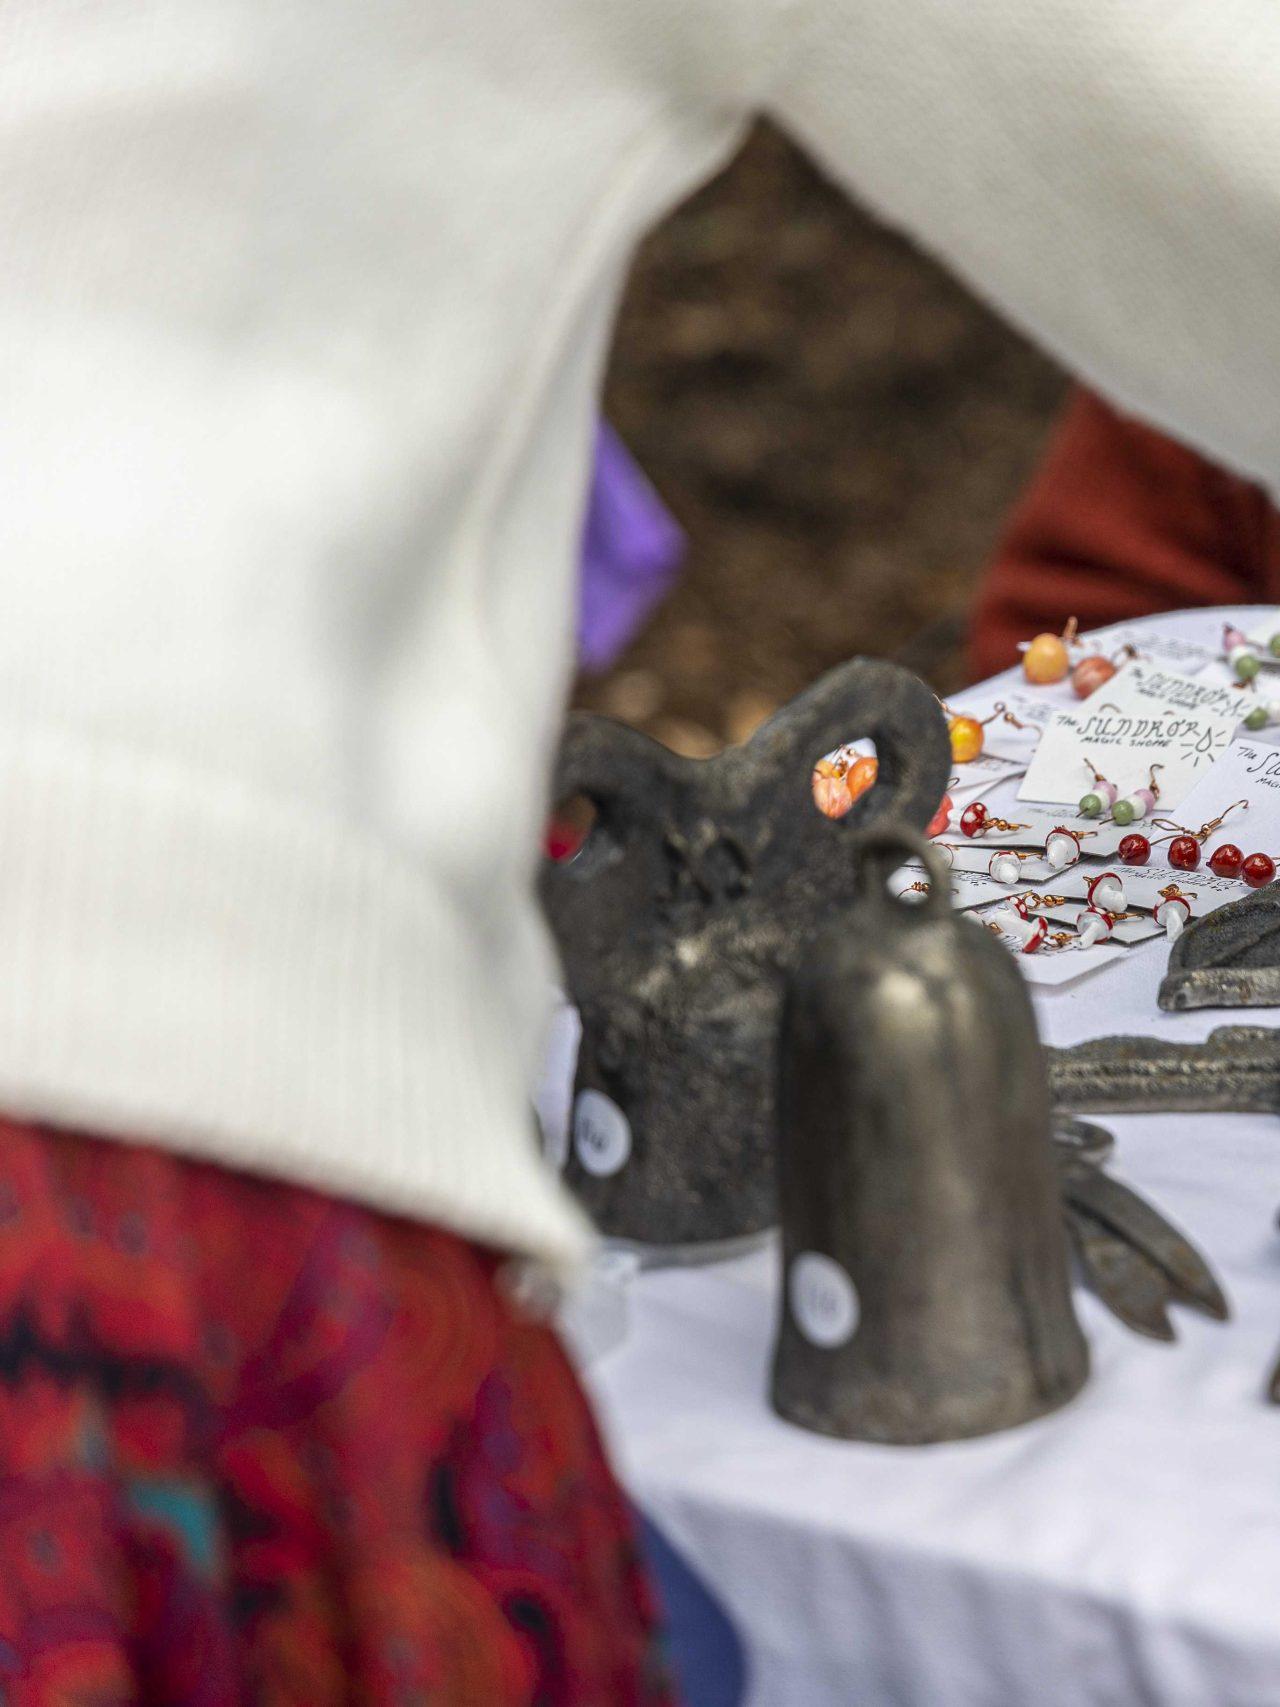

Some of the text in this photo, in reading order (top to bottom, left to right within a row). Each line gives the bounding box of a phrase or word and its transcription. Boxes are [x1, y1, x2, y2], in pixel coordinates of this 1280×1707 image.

[1056, 715, 1198, 738] The SUNDROP
[1080, 737, 1122, 746] MAGIC
[1237, 746, 1258, 759] The
